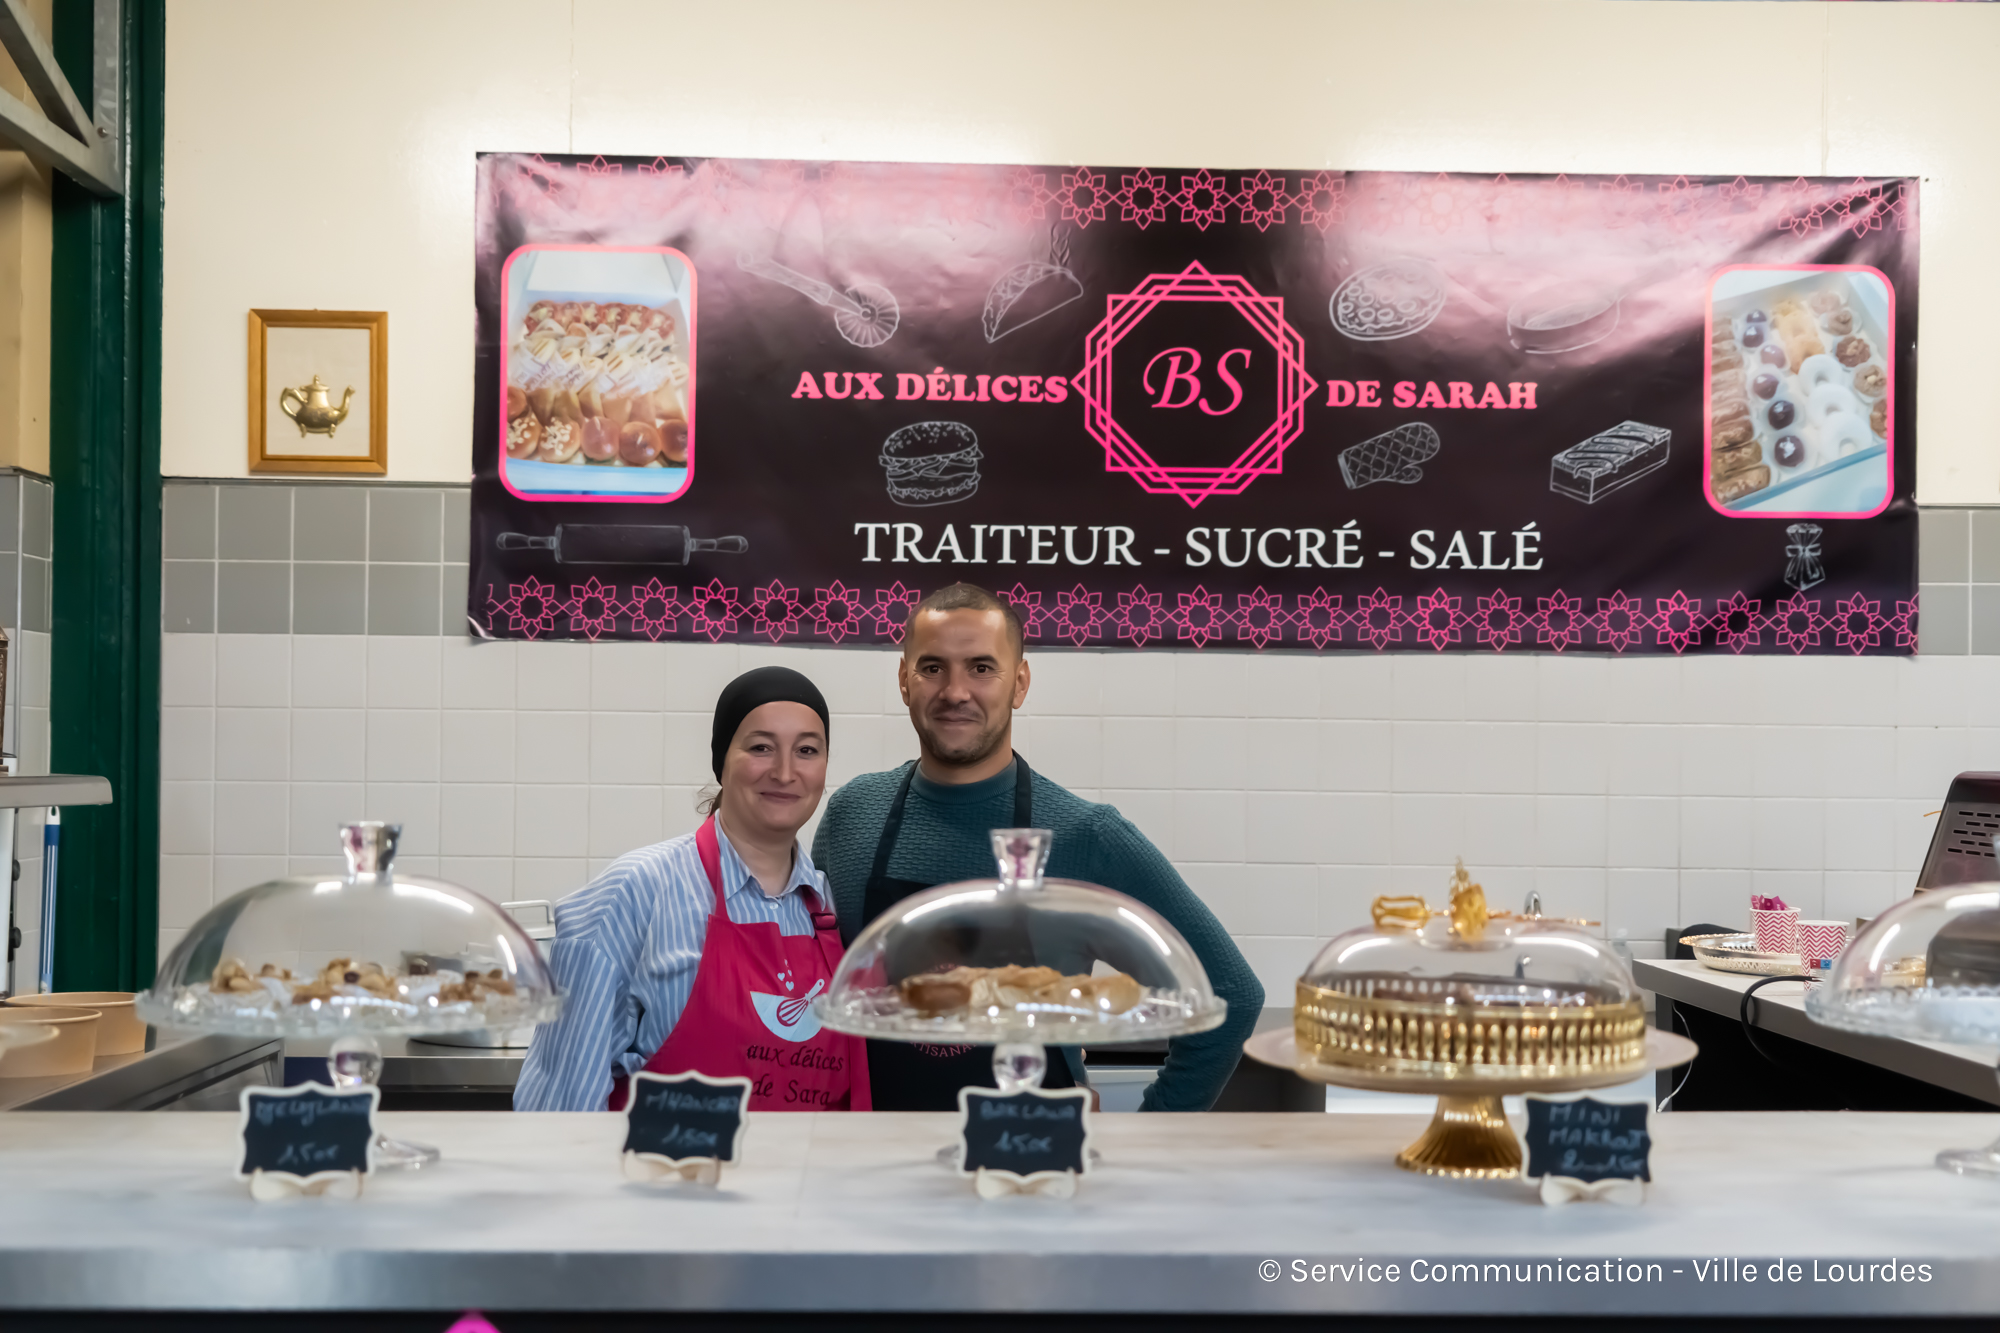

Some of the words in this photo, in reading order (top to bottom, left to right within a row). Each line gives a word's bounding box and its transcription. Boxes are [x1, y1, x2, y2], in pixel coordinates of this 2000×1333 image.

[791, 370, 886, 401] AUX
[896, 366, 1069, 404] DÉLICES
[1143, 346, 1253, 417] BS
[1325, 380, 1383, 408] DE
[1392, 381, 1539, 410] SARAH
[853, 521, 1142, 566] TRAITEUR
[1185, 519, 1365, 569] SUCRÉ
[1409, 521, 1544, 571] SALÉ
[747, 1045, 785, 1067] aux
[791, 1045, 844, 1072] délices
[752, 1073, 774, 1098] de
[784, 1079, 831, 1106] Sara
[1549, 1104, 1621, 1126] MINI
